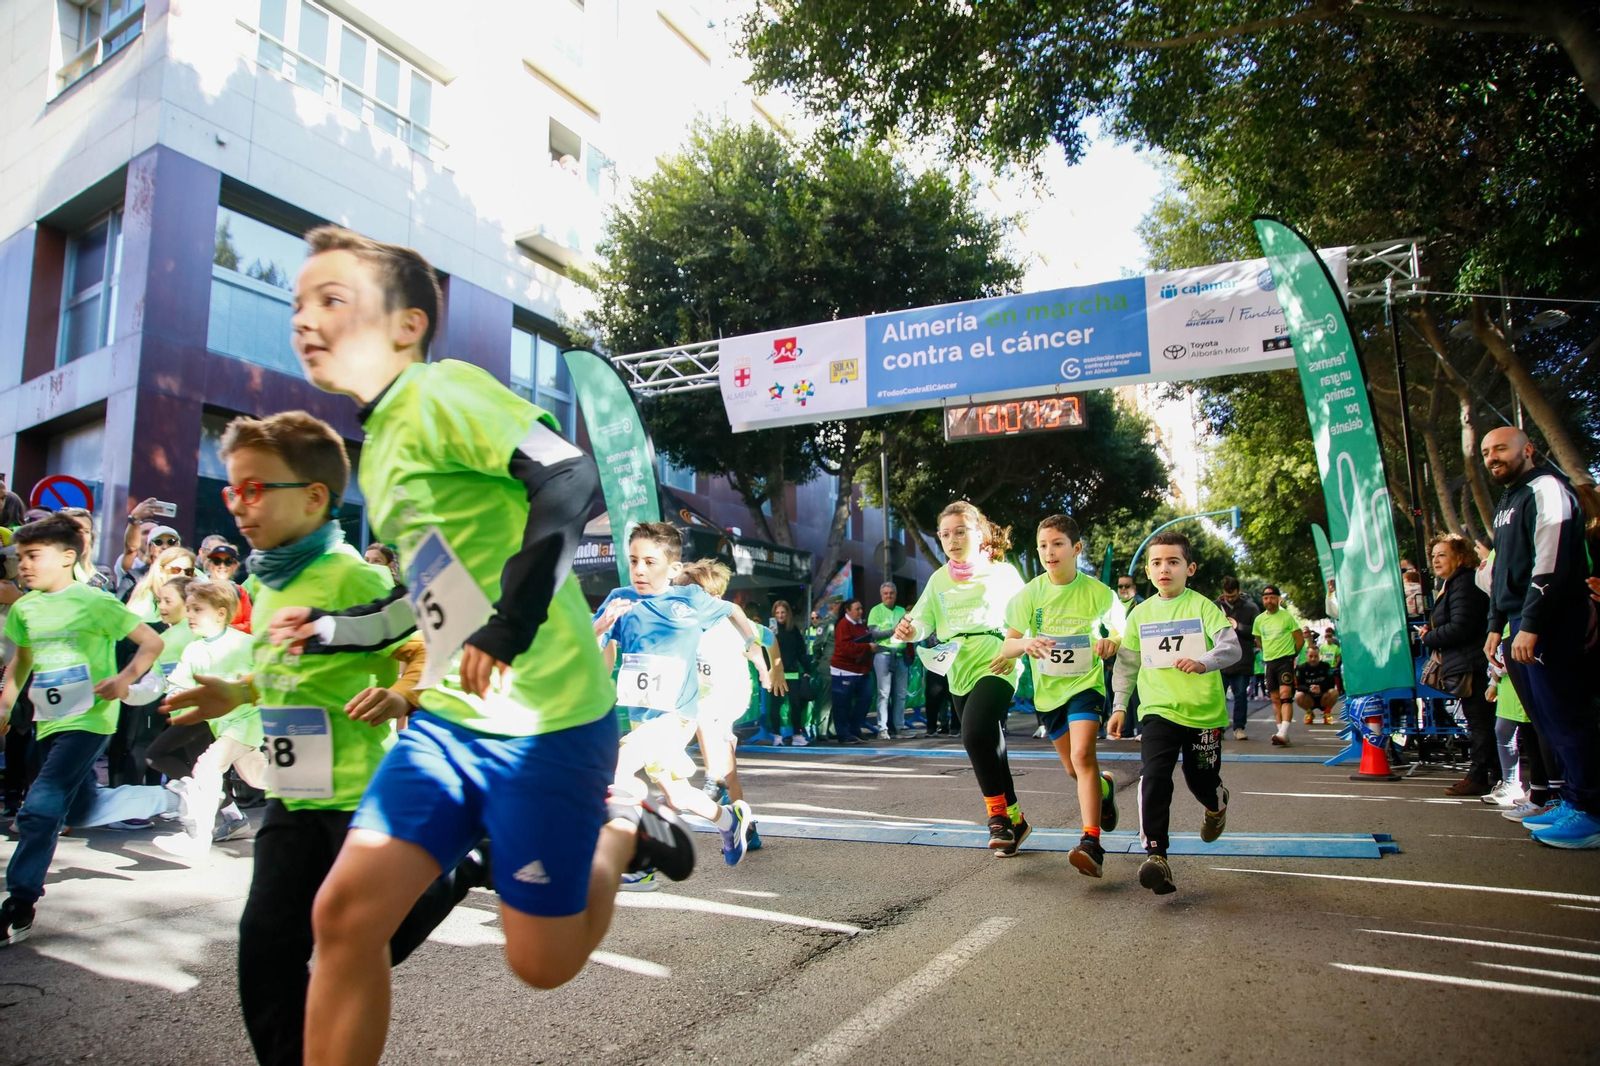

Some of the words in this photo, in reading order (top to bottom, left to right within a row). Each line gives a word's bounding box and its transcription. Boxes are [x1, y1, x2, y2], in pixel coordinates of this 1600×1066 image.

[1182, 279, 1238, 296] cajamar
[882, 311, 978, 344] Almería
[986, 309, 1017, 327] en
[1026, 292, 1128, 322] marcha
[1185, 317, 1225, 327] MICHELIN
[882, 344, 963, 371] contra
[969, 335, 995, 359] el
[1001, 327, 1095, 354] cáncer
[1190, 340, 1219, 349] Toyota
[1190, 348, 1223, 358] Alborán
[1225, 345, 1250, 354] Motor
[1083, 354, 1115, 363] asociación
[877, 382, 957, 398] #TodosContraElCáncer
[1158, 635, 1184, 652] 47
[1050, 649, 1075, 664] 52
[636, 672, 662, 691] 61
[46, 688, 62, 705] 6
